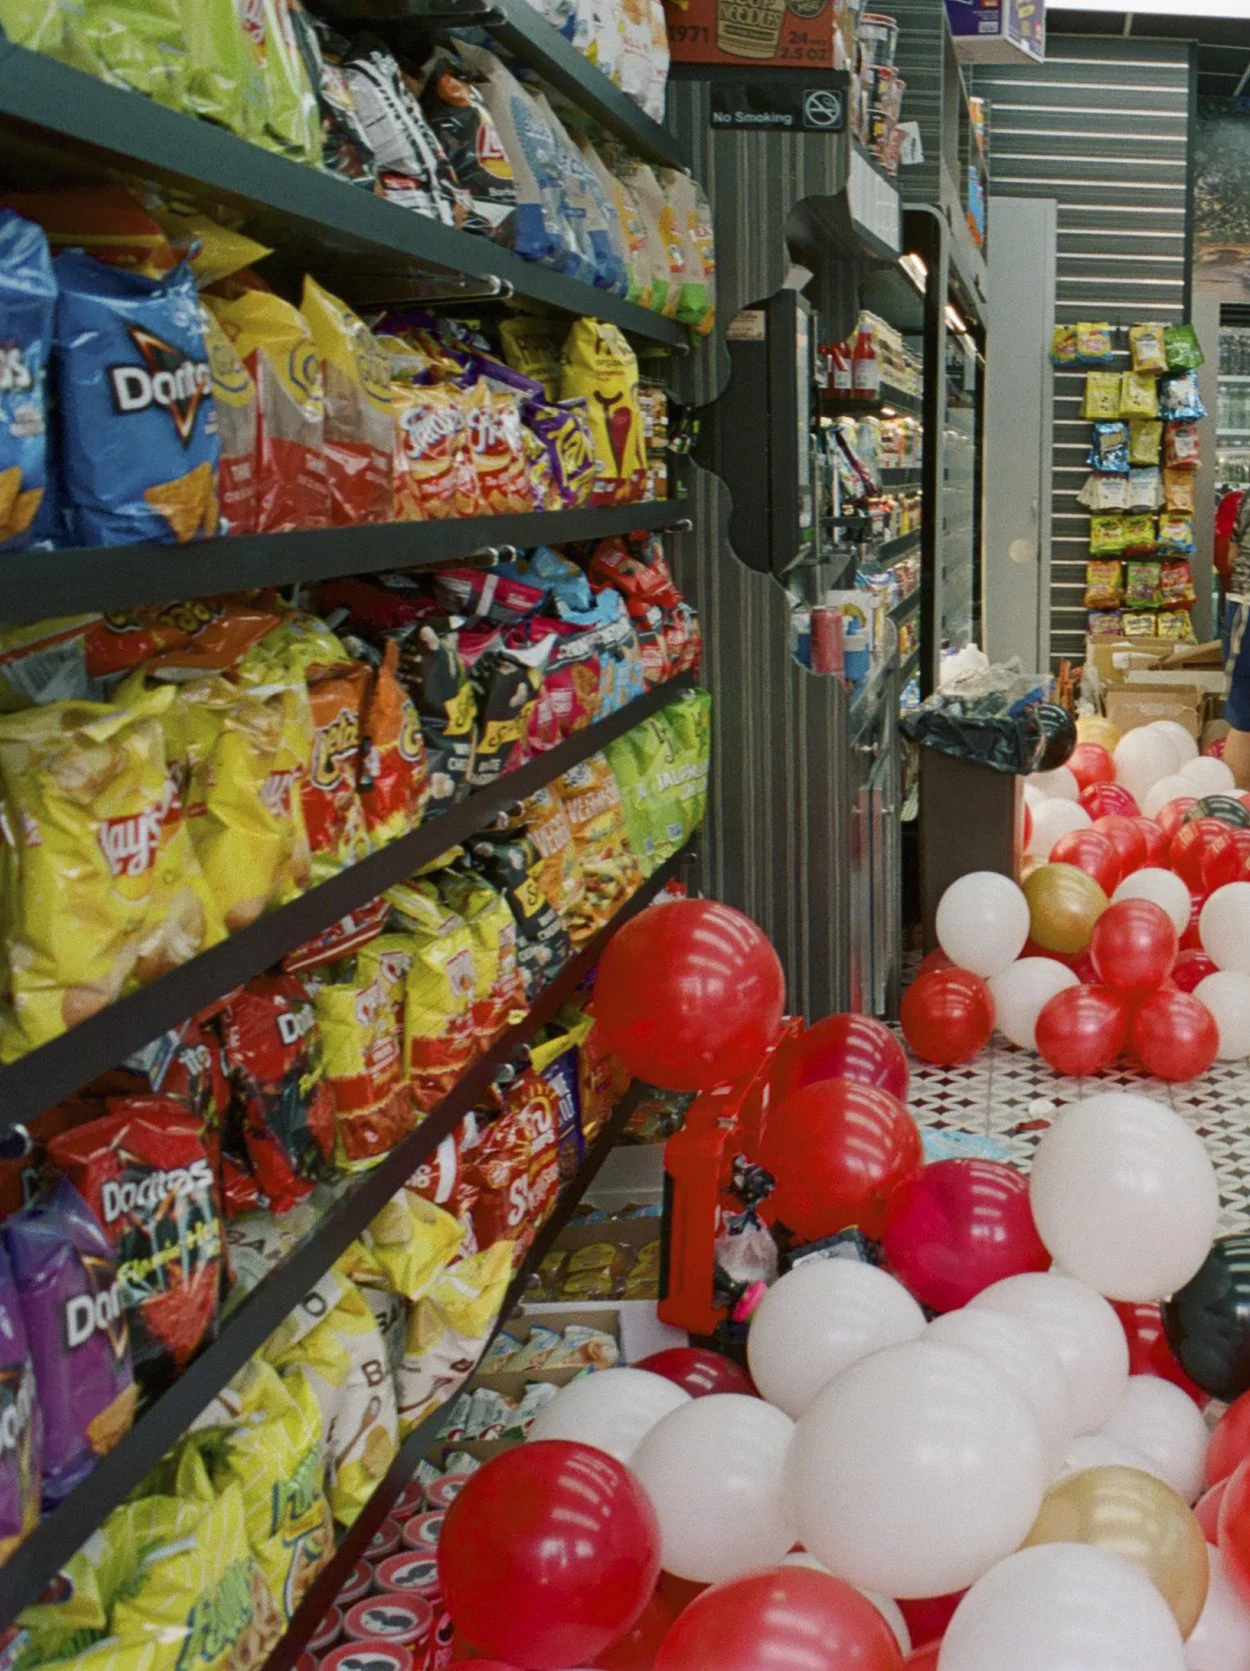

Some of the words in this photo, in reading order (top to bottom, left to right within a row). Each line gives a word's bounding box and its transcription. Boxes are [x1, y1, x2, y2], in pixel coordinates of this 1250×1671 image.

[712, 112, 732, 124] No
[735, 111, 793, 126] Smoking
[102, 1158, 214, 1224] Doritos
